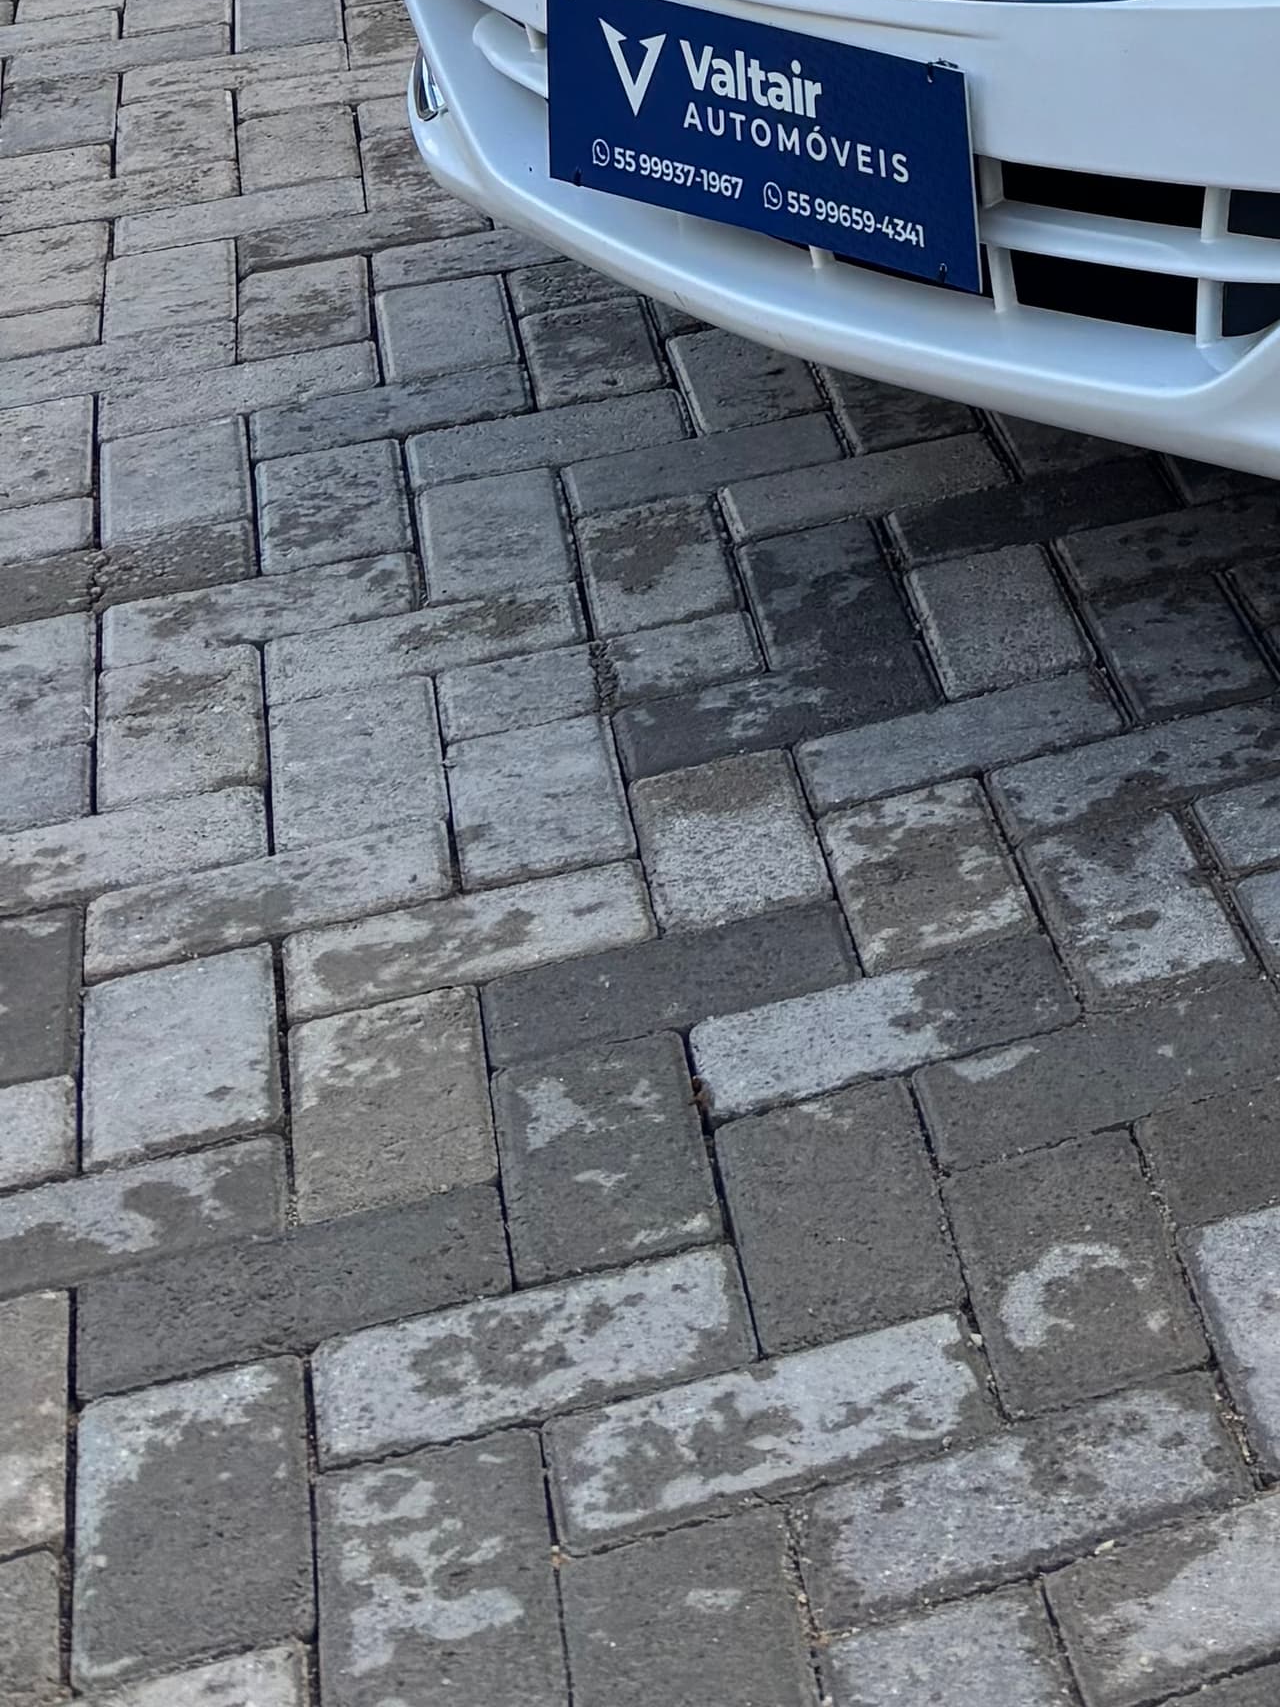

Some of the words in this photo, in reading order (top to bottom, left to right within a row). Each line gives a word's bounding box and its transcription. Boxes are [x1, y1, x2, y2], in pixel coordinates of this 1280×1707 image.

[679, 39, 822, 119] Valtair
[614, 146, 636, 172] 55
[639, 153, 743, 199] 99937-1967
[683, 102, 909, 183] AUTOMÓVEIS
[787, 190, 811, 216] 55
[814, 198, 925, 248] 99659-4341
